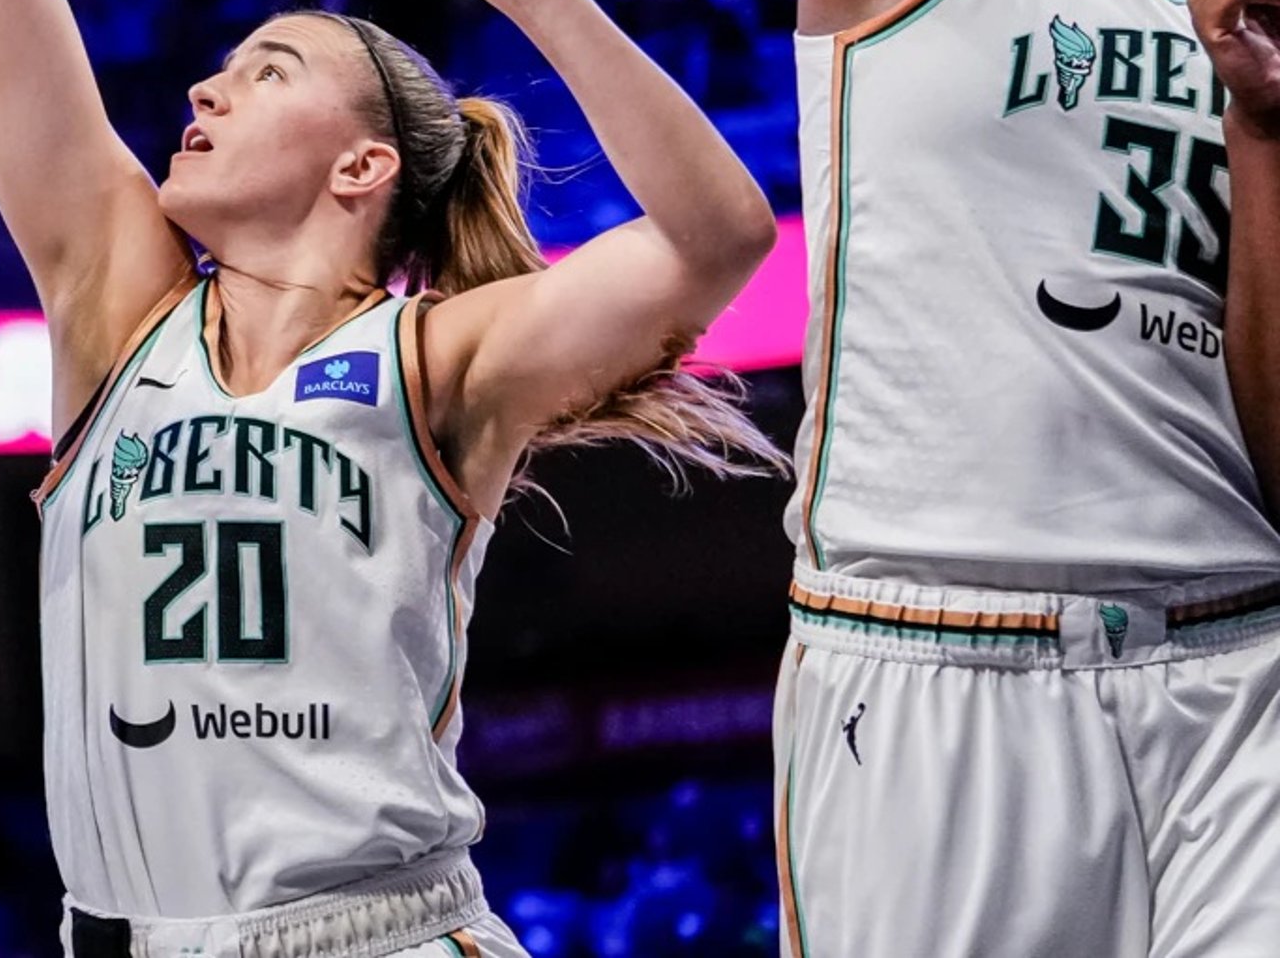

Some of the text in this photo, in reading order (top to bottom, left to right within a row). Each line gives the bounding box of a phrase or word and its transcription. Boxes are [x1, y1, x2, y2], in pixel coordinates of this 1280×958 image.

[1140, 303, 1220, 359] Web
[303, 380, 370, 395] BARCLAYS
[143, 519, 290, 665] 20
[190, 702, 331, 740] Webull
